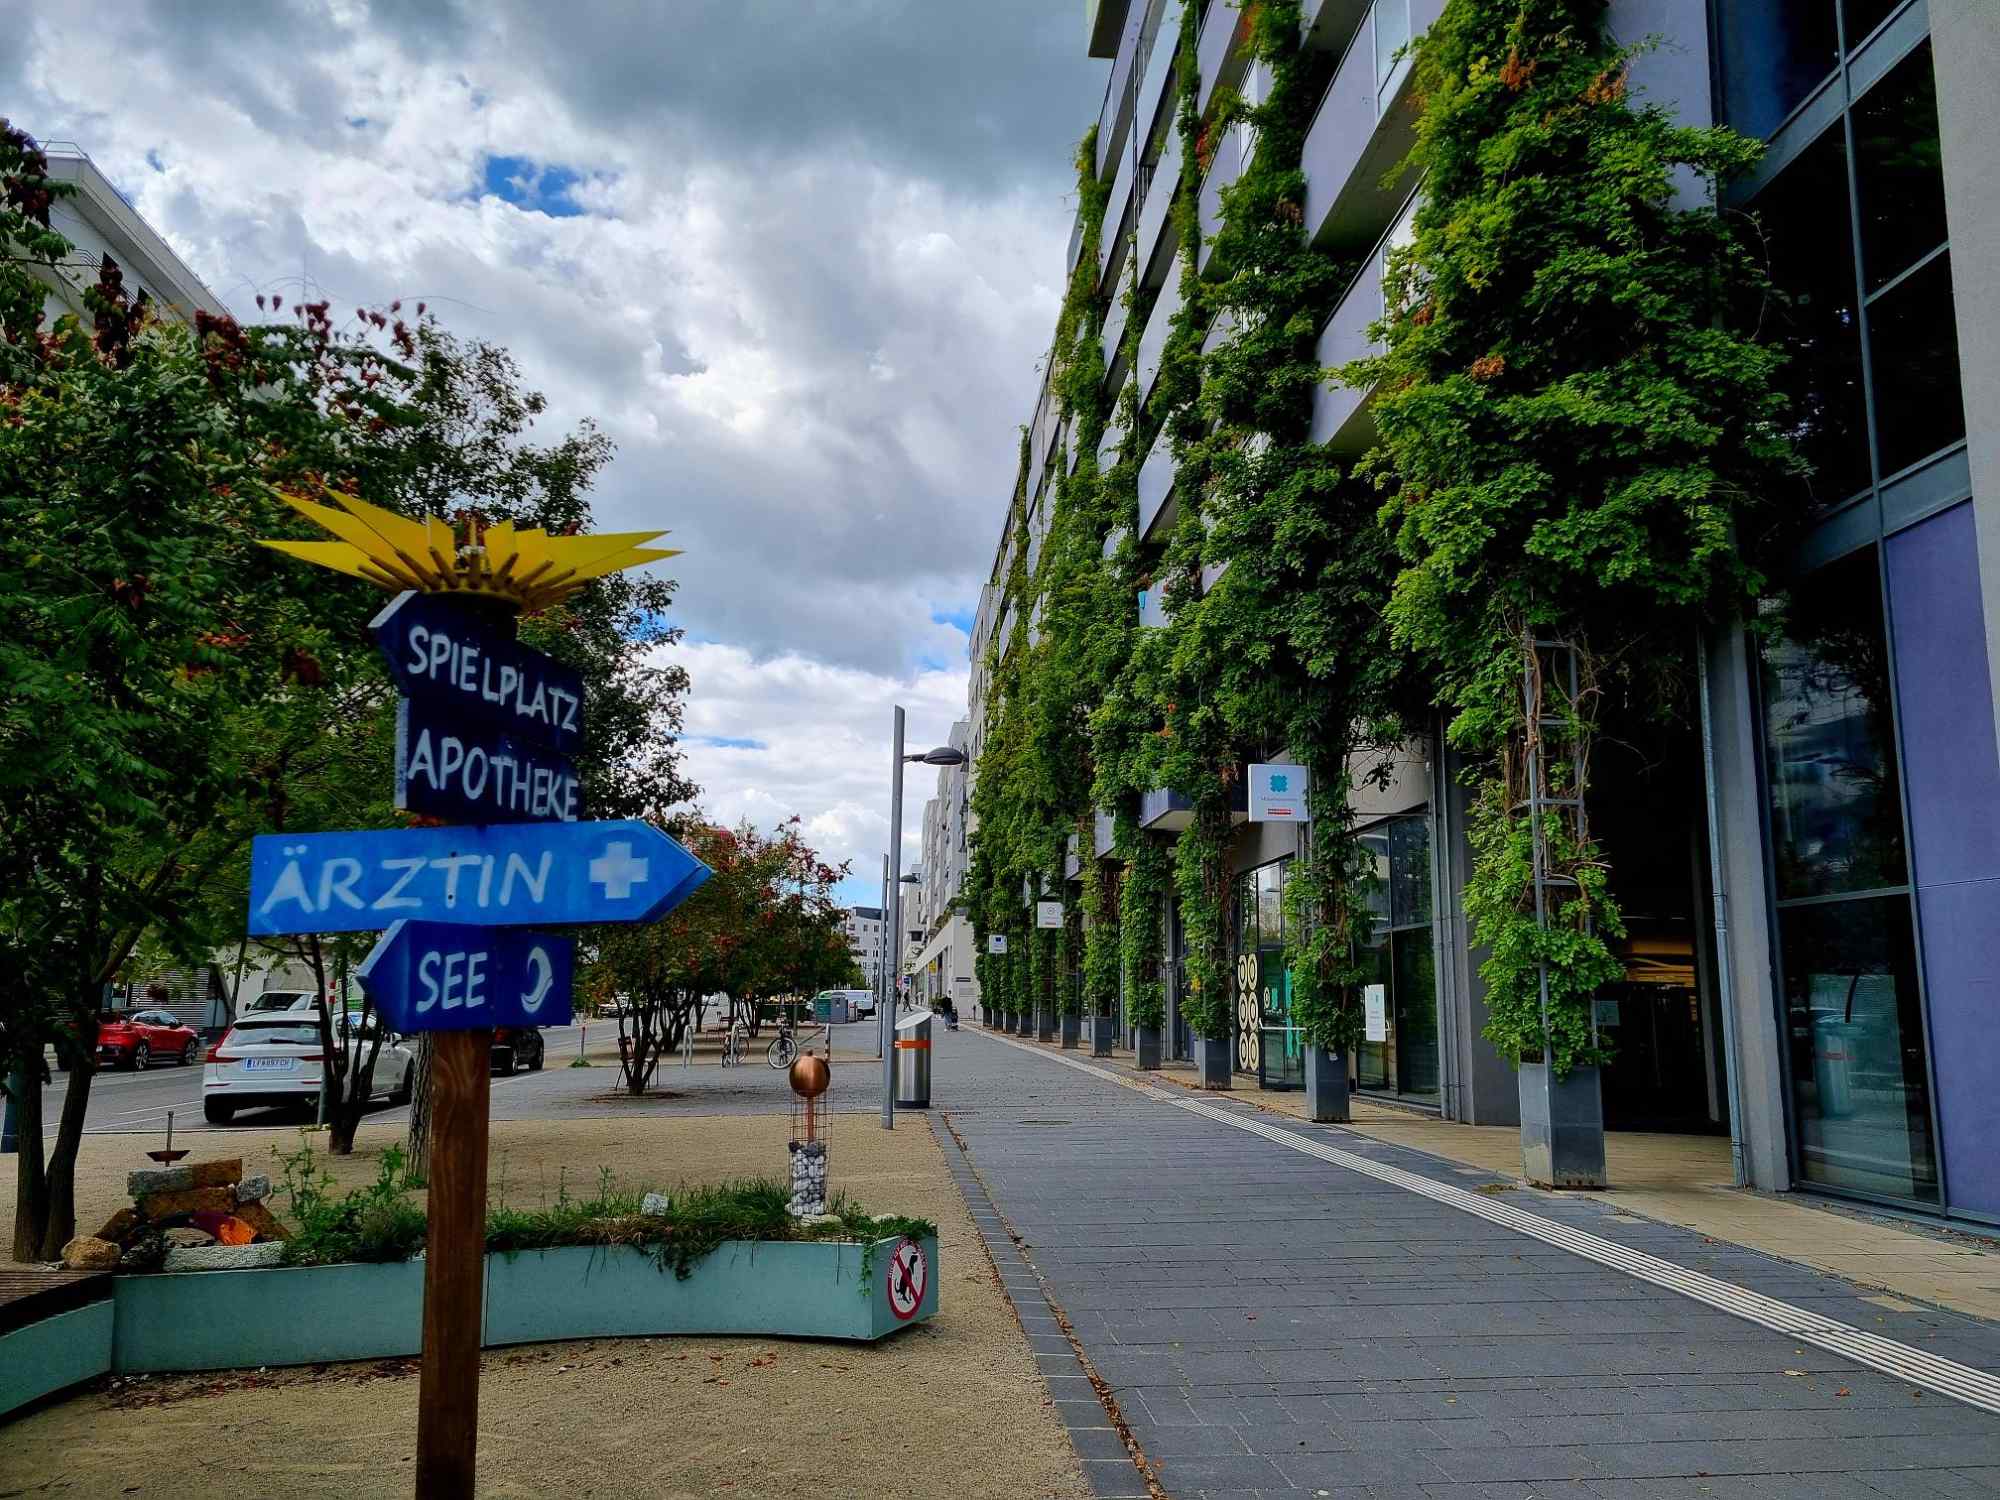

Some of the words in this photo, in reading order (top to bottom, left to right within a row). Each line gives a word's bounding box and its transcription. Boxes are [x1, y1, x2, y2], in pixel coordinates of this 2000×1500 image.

[407, 625, 579, 733] SPIELPLATZ
[407, 728, 578, 822] APOTHEKE
[260, 844, 553, 914] ÄRZTIN
[415, 951, 488, 1013] SEE
